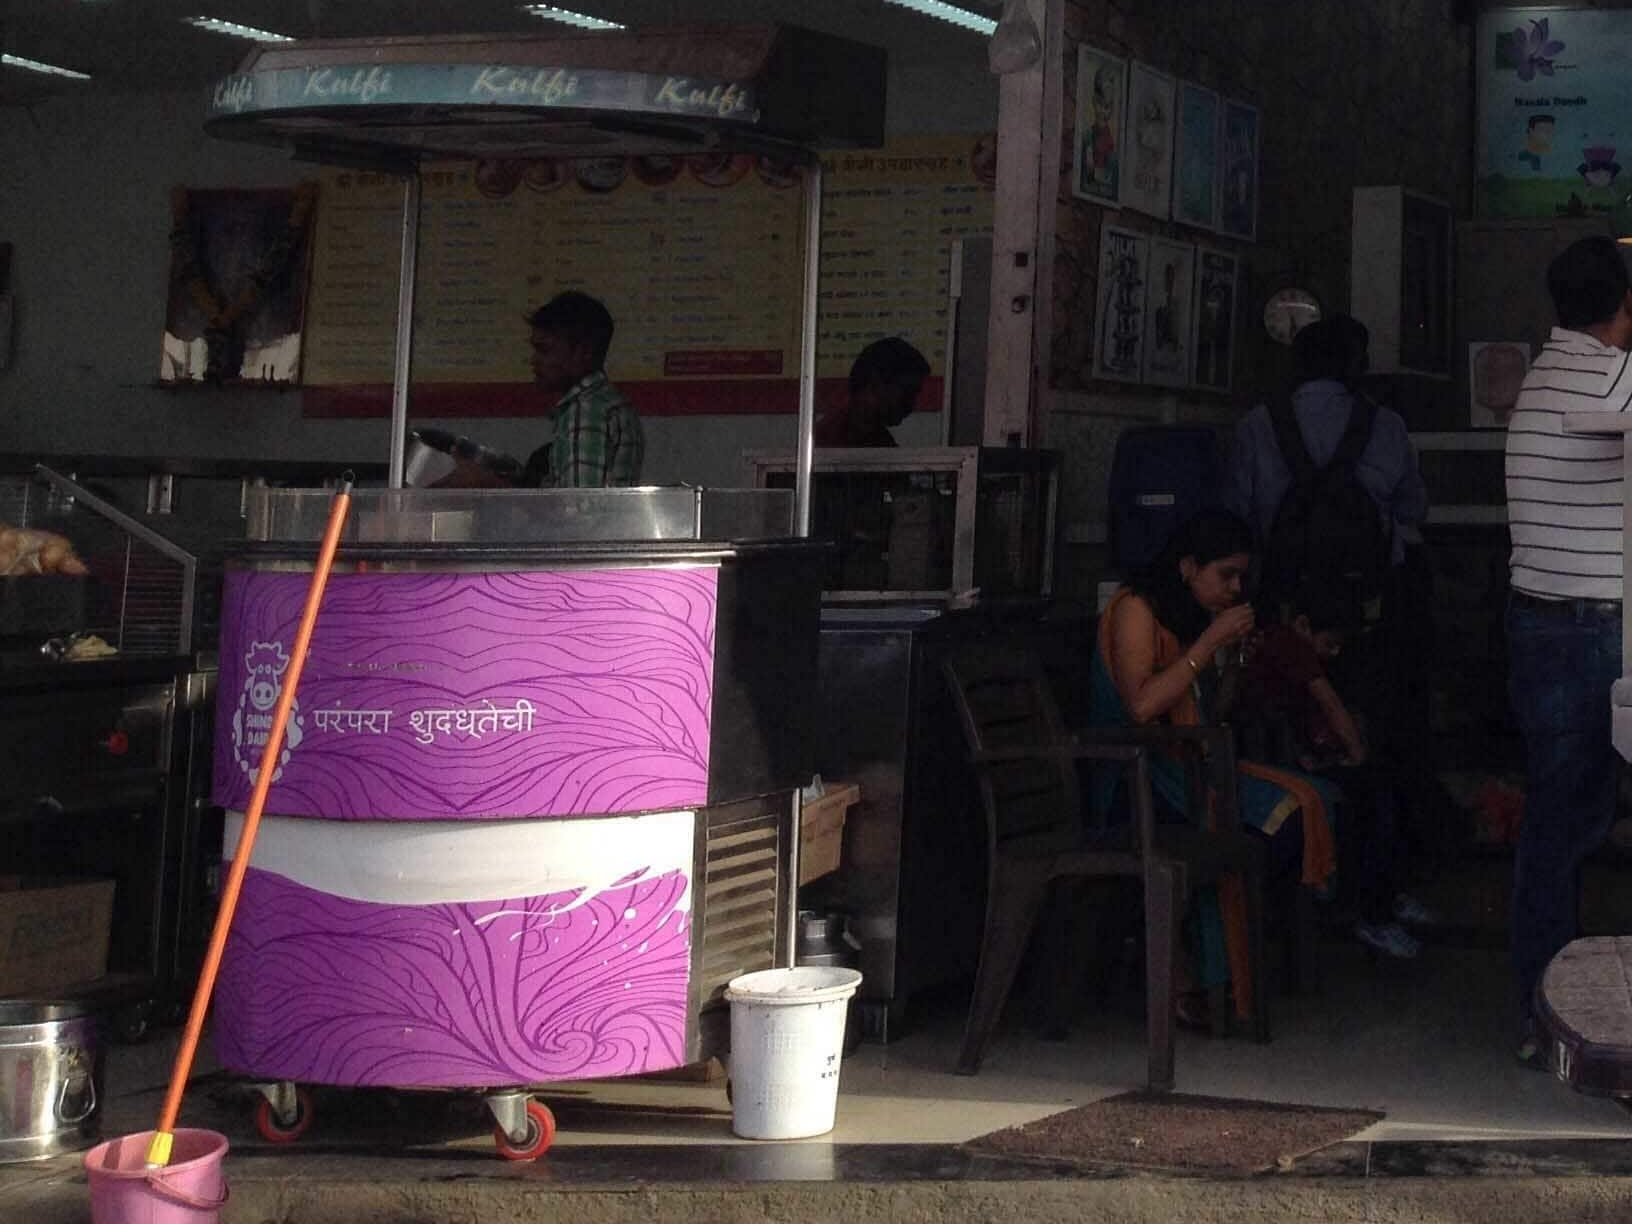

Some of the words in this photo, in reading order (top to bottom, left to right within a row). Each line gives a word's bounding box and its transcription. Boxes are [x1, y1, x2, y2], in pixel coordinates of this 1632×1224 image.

[304, 66, 391, 104] Kulfi
[471, 66, 578, 105] Kulfi
[656, 78, 746, 117] Kulfi
[313, 700, 393, 735] परंपरा
